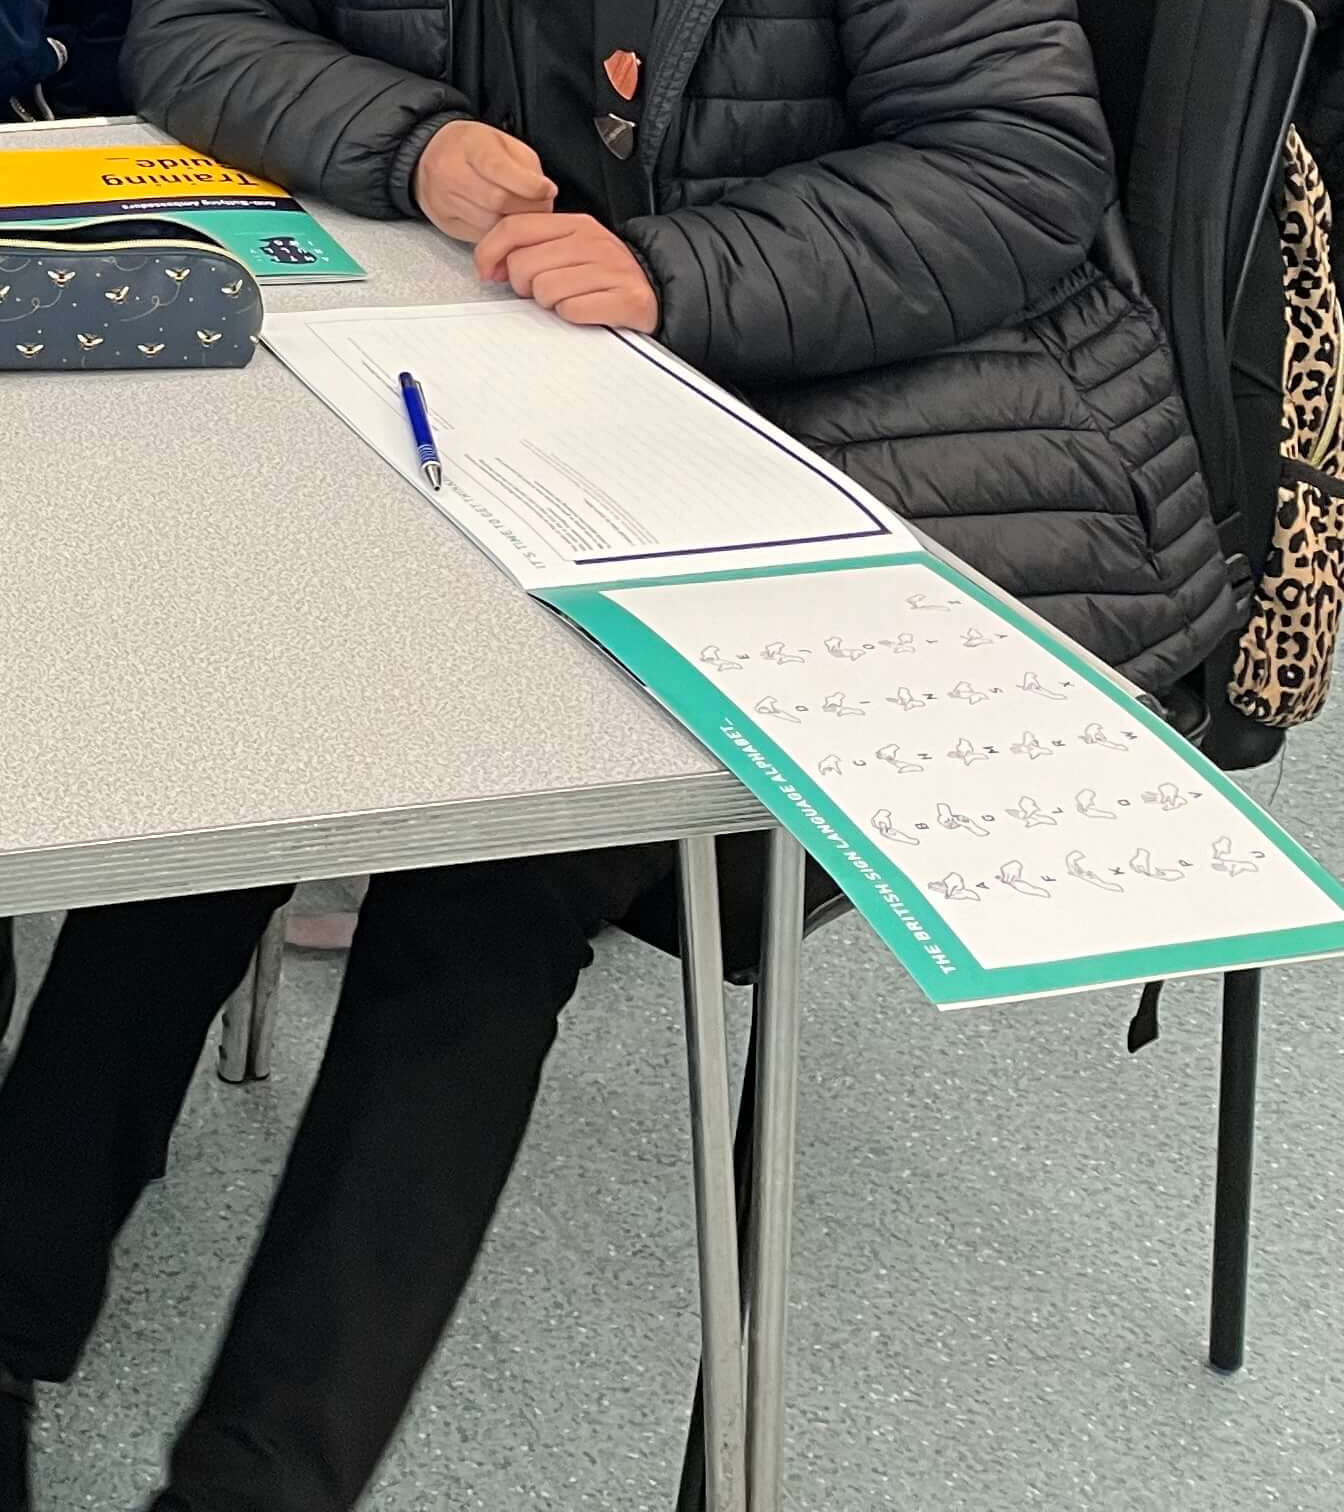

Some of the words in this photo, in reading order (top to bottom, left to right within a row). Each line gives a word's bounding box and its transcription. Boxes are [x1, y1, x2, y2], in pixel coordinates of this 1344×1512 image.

[100, 173, 257, 188] Training
[121, 200, 200, 211] Ambassadors
[779, 783, 851, 853] LANGUAGE
[845, 850, 881, 887] SIGN
[874, 882, 931, 944] BRITISH
[926, 940, 957, 975] THE
